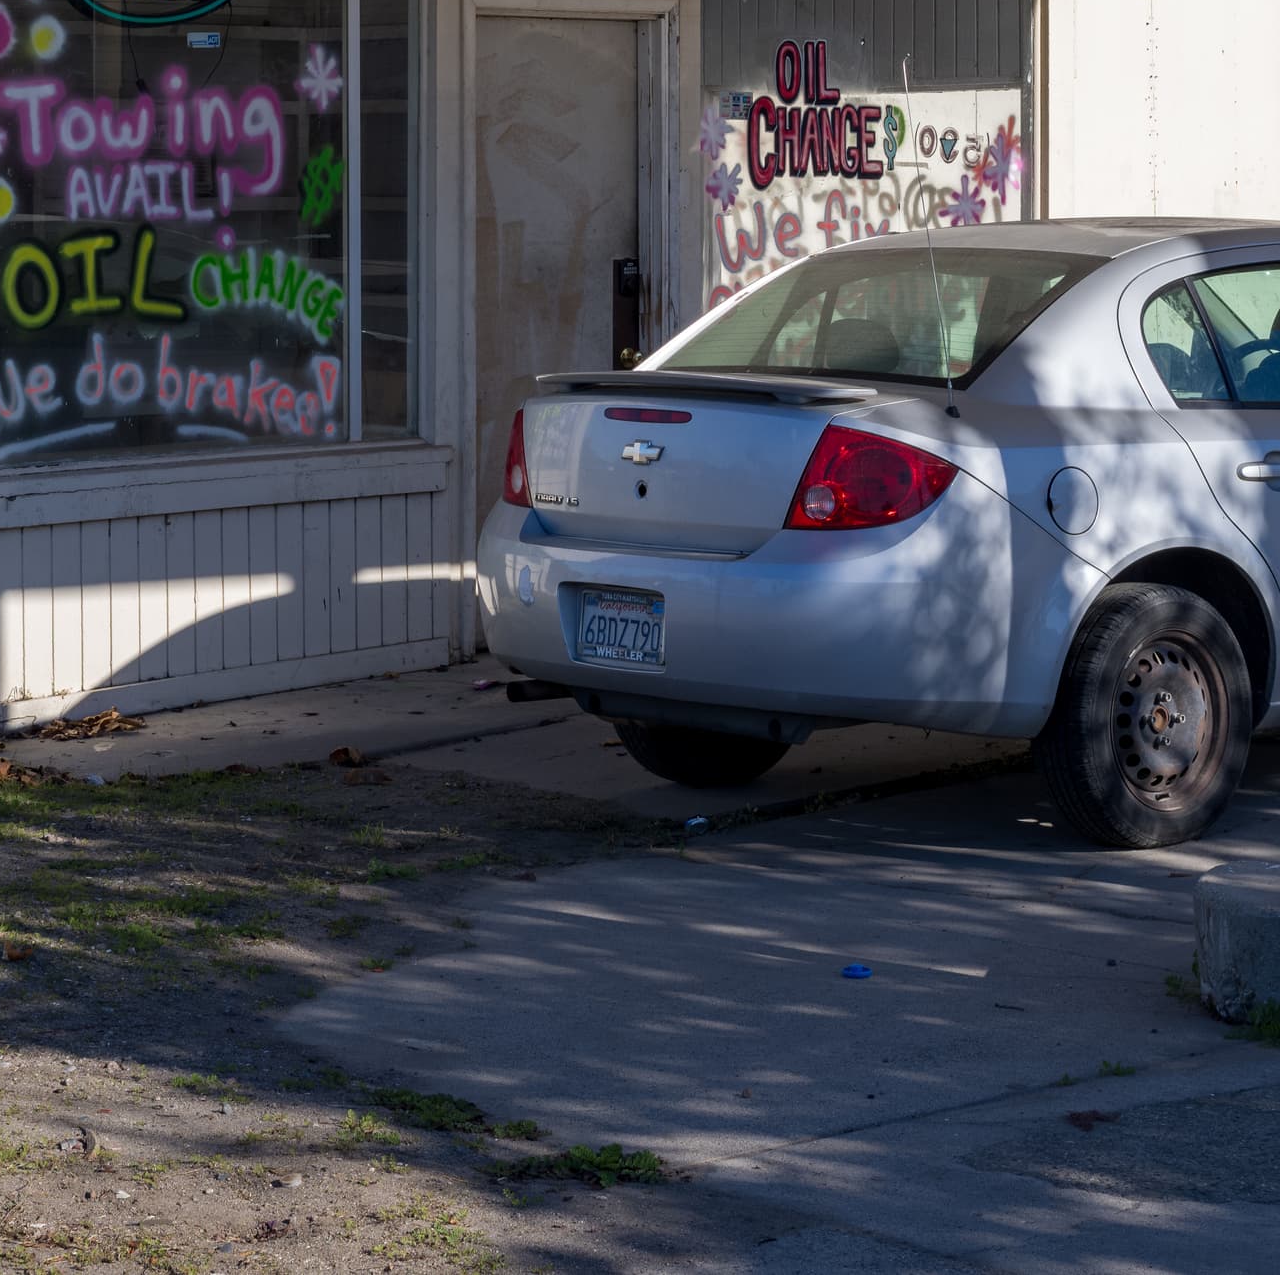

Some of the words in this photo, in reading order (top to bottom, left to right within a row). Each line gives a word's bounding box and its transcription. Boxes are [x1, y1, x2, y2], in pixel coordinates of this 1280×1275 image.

[775, 39, 841, 106] OIL
[714, 200, 803, 274] We
[1, 229, 185, 327] OIL
[190, 252, 345, 342] CHANGE
[76, 332, 144, 405] do
[584, 614, 662, 652] 6BDZ790
[594, 645, 644, 662] WHEELER
